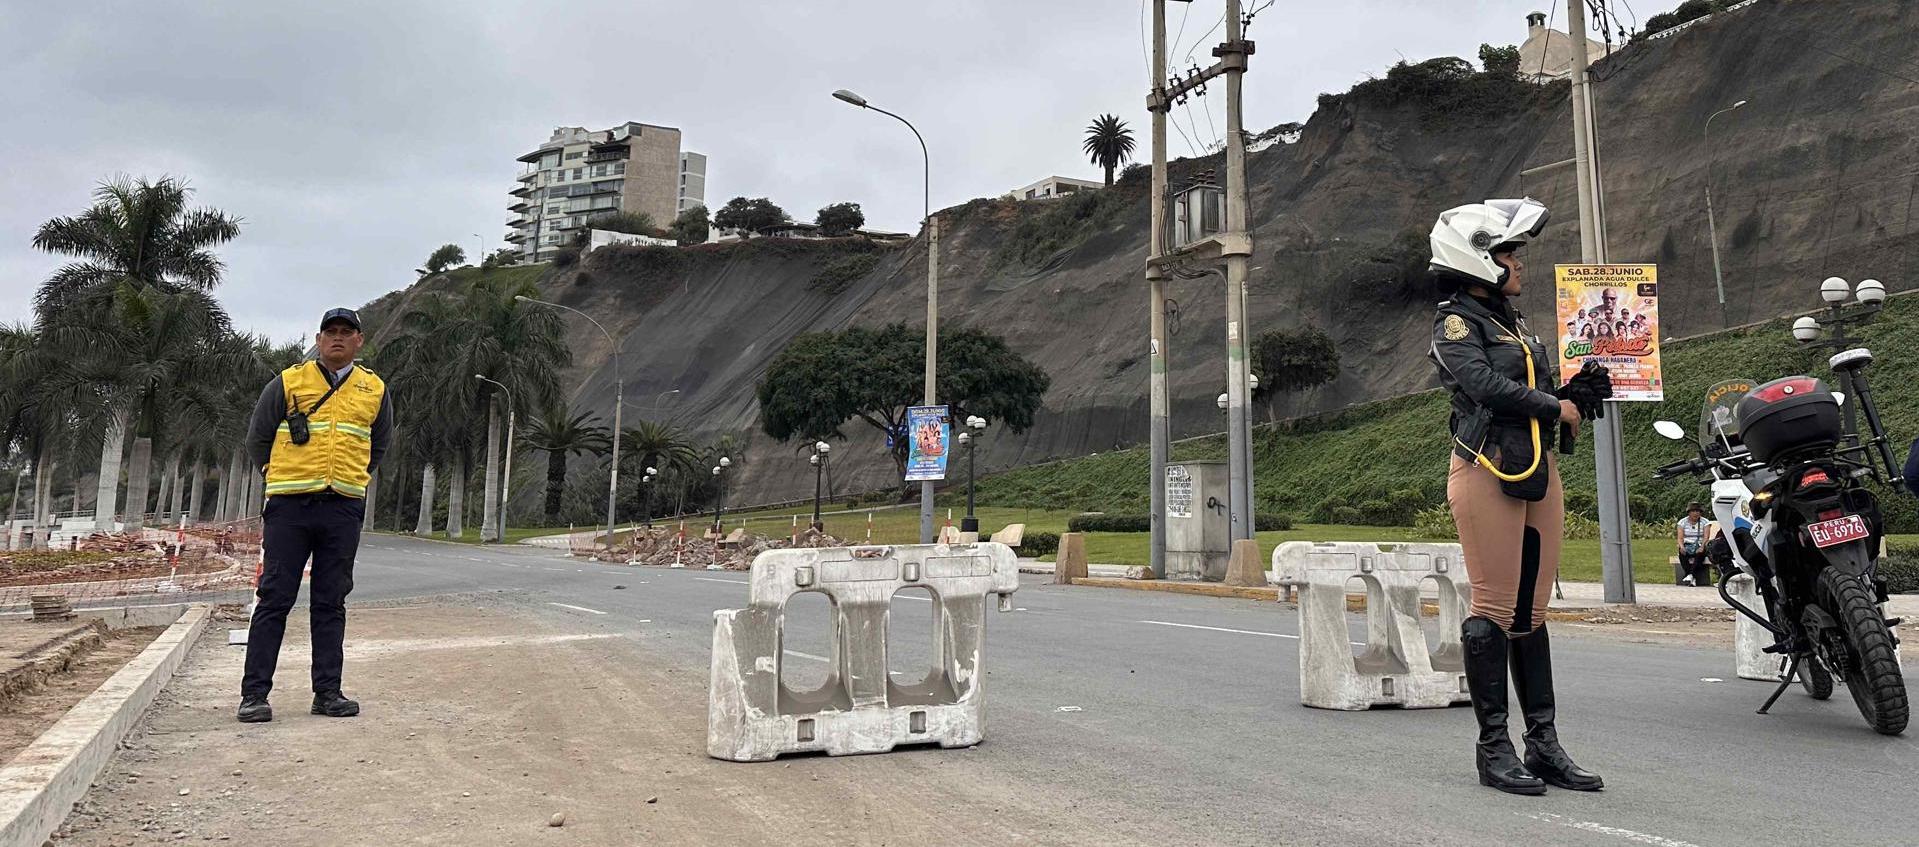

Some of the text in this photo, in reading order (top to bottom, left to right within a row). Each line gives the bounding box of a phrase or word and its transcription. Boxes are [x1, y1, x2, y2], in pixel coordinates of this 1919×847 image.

[1567, 267, 1643, 276] SAB.28.JUNIO
[1564, 340, 1593, 359] San
[1823, 519, 1845, 529] PERU
[1813, 522, 1863, 543] EU-6976
